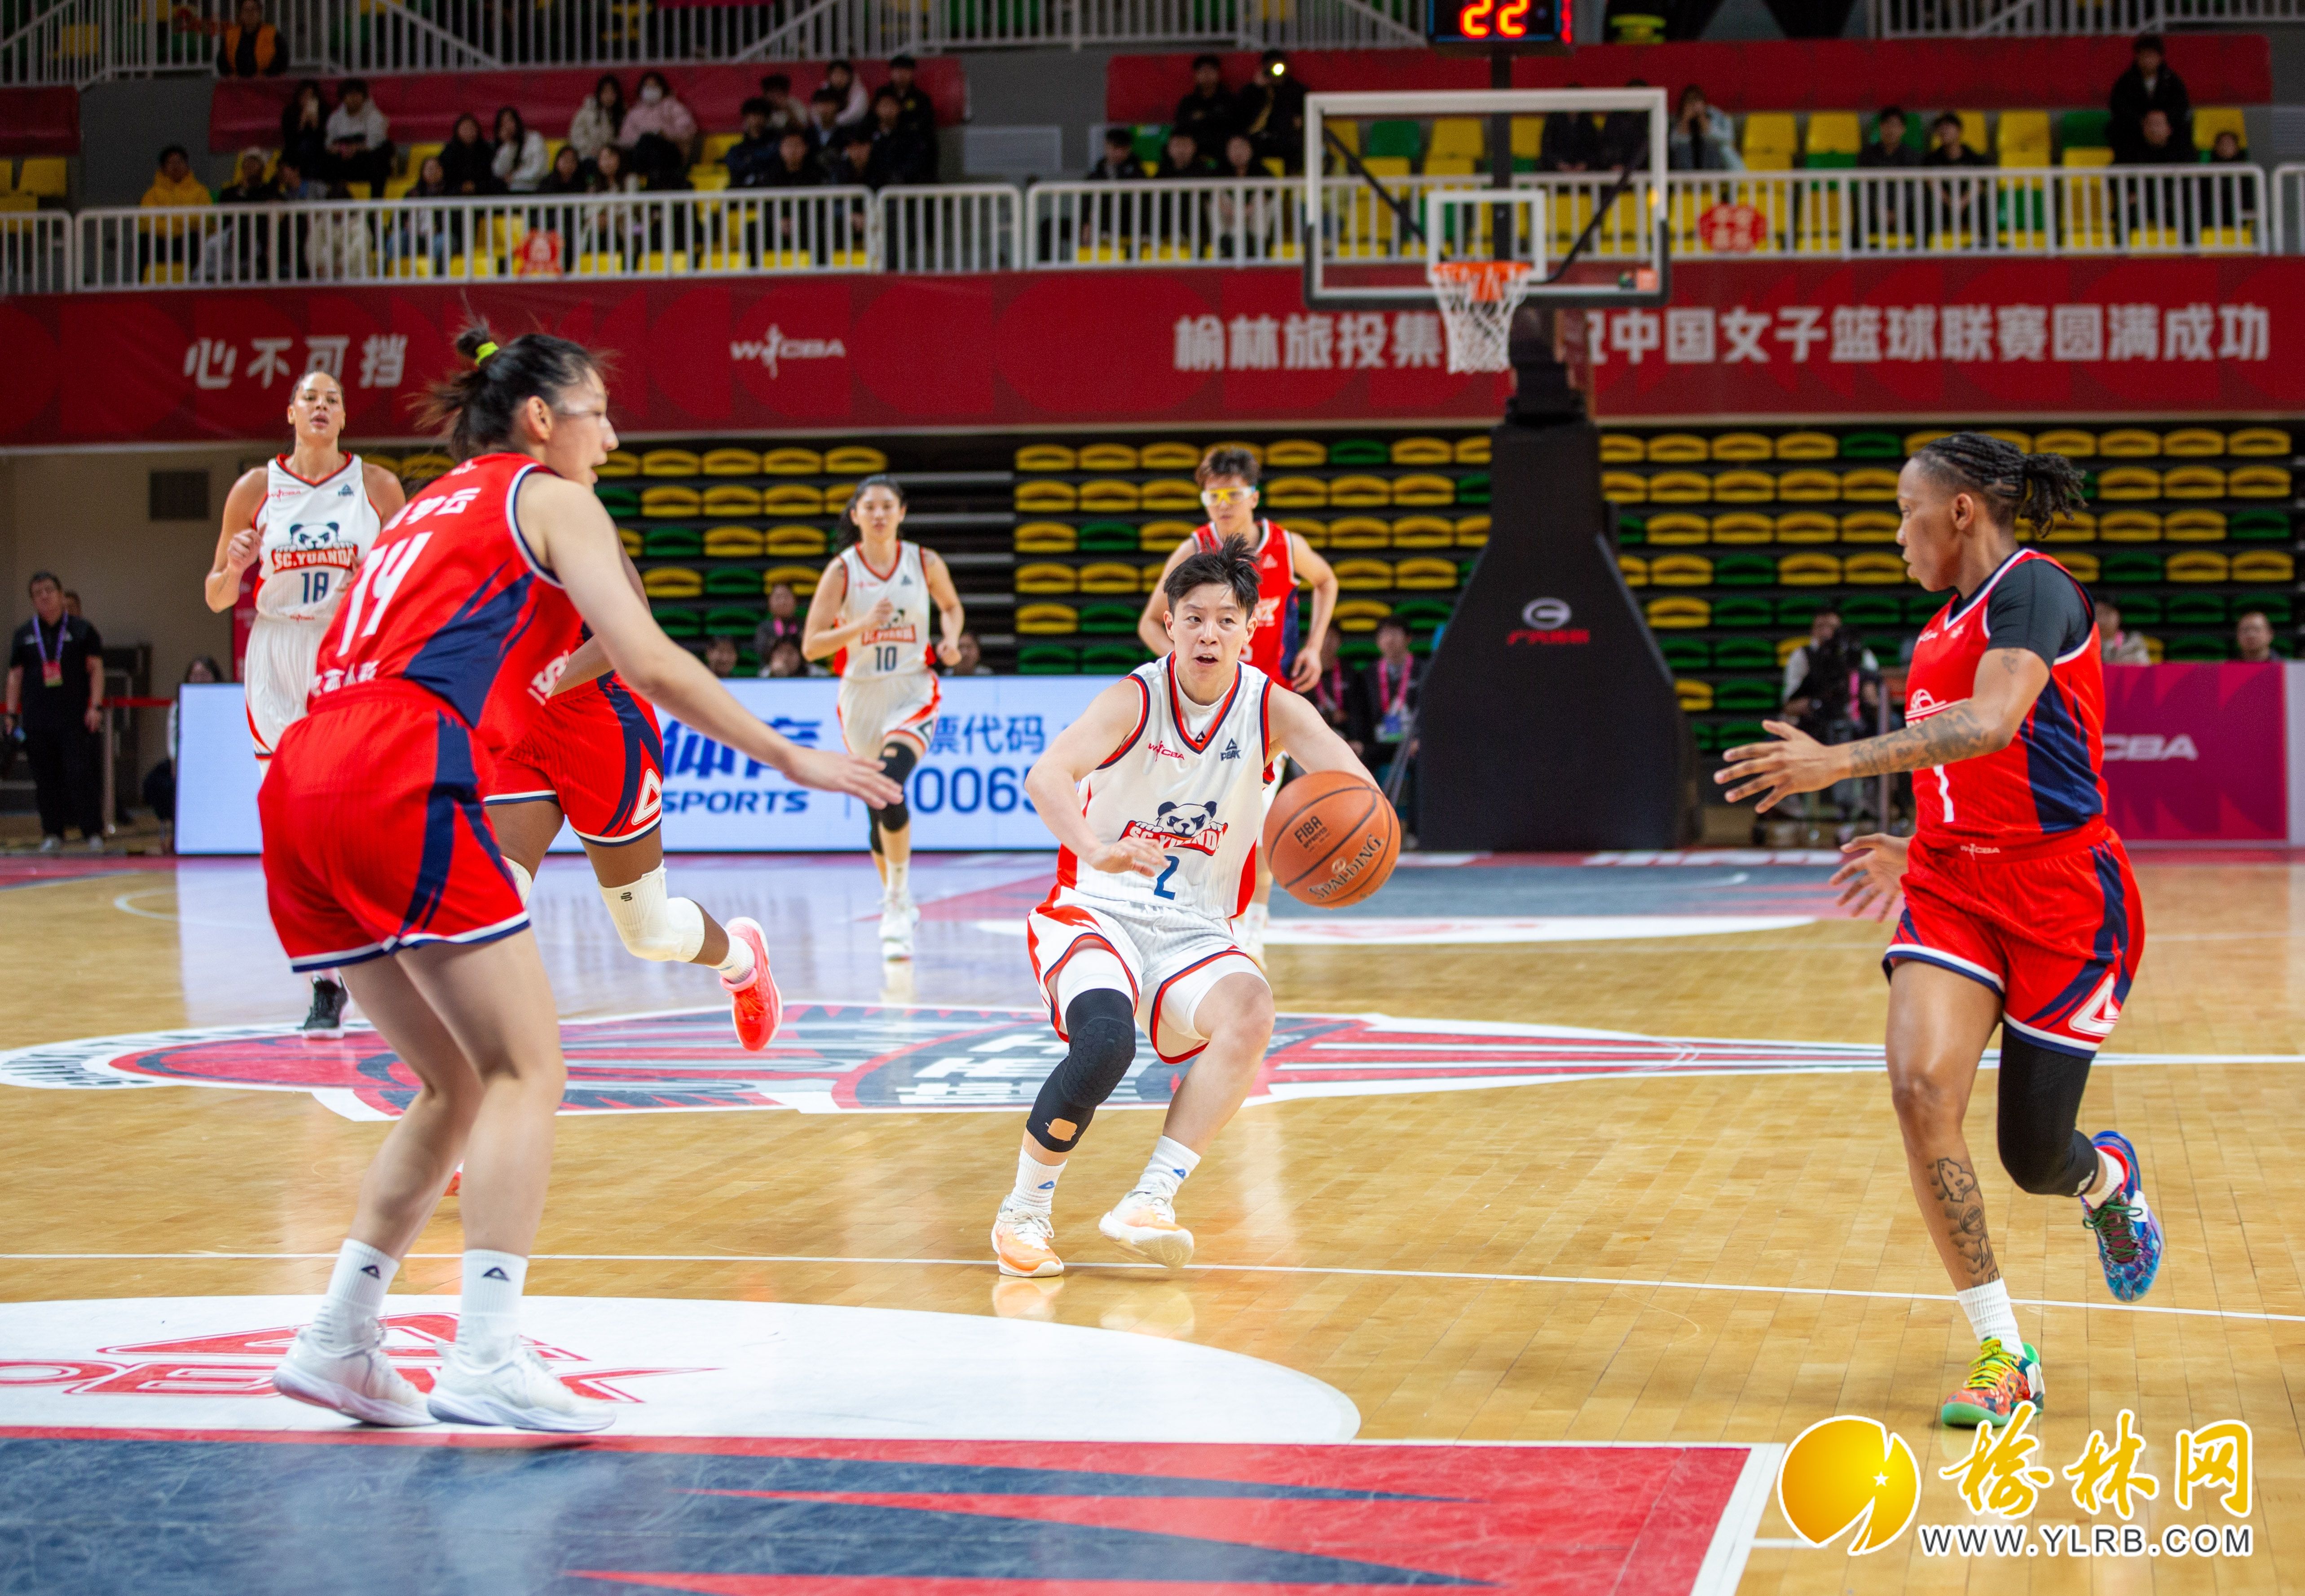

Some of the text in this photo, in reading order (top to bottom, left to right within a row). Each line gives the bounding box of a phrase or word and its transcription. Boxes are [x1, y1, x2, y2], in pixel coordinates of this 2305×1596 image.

[1460, 0, 1530, 38] 22
[1173, 304, 2270, 371] 榆林旅投集中国女子篮球联赛圆满成功
[183, 335, 407, 390] 心不可挡
[336, 531, 434, 658] 14
[875, 646, 897, 672] 10
[662, 790, 809, 813] SPORTS
[1295, 815, 1322, 844] FIBA
[1154, 855, 1180, 900] 2
[1308, 834, 1382, 899] SPALDING
